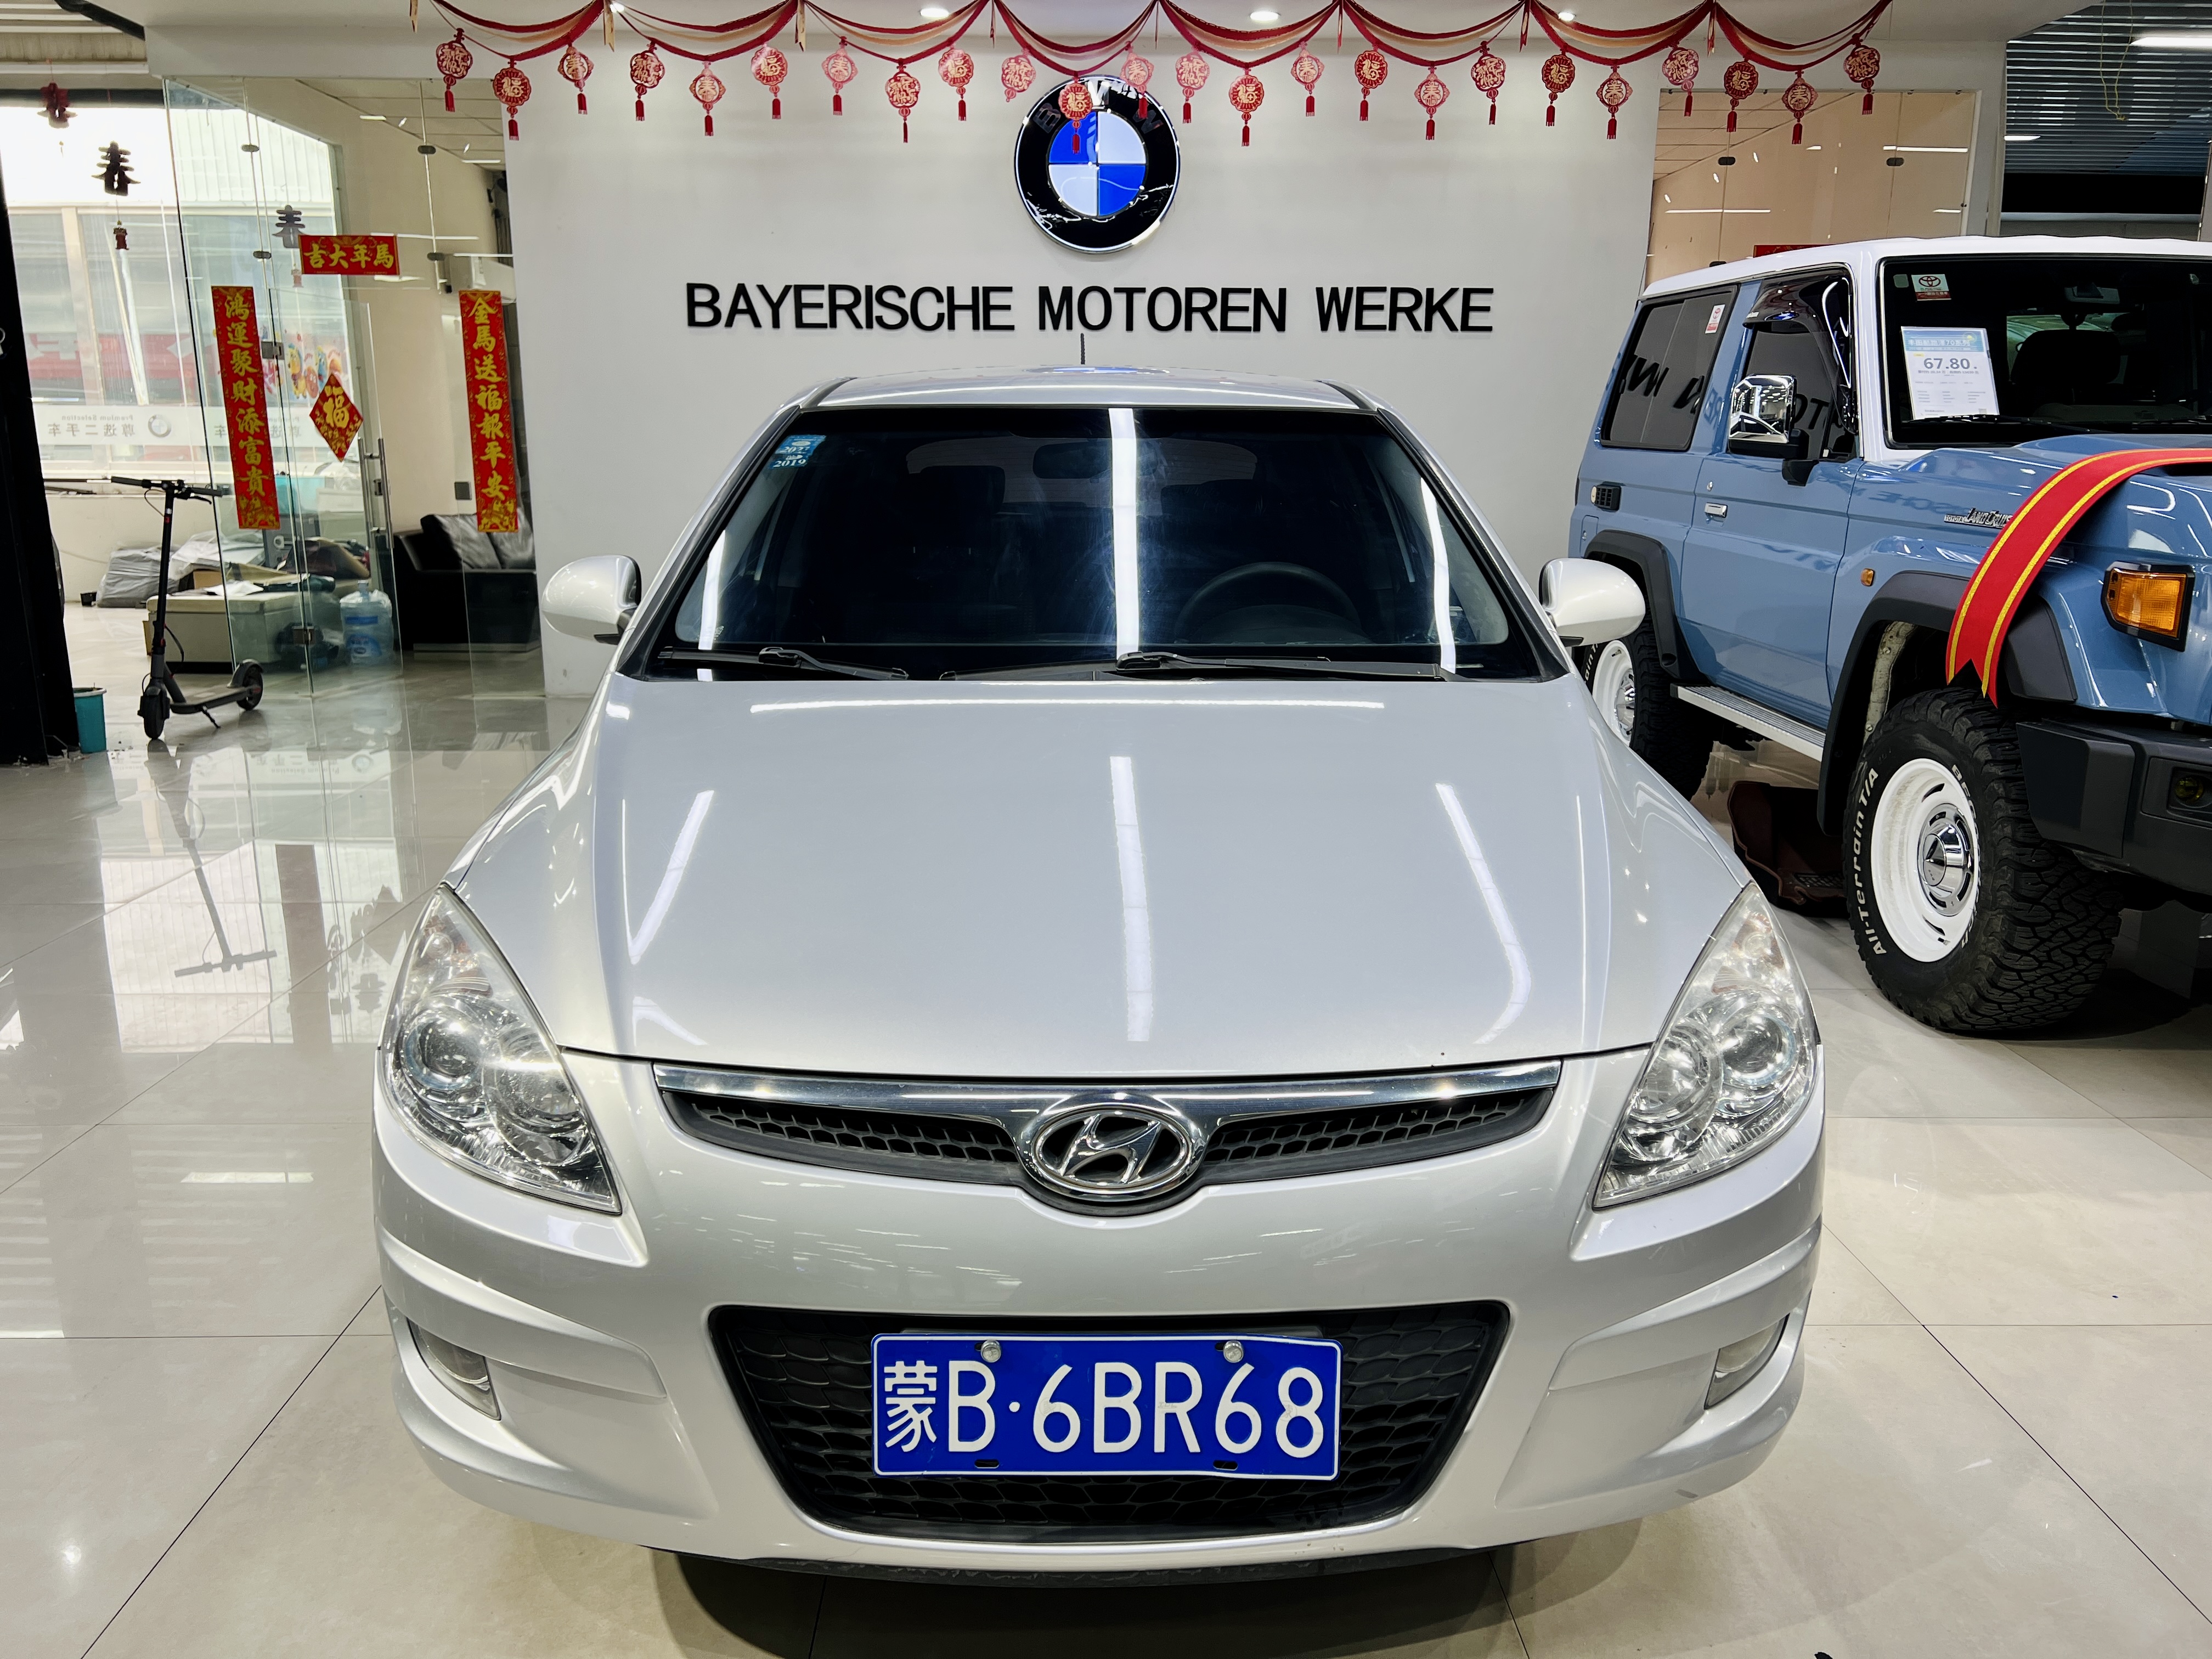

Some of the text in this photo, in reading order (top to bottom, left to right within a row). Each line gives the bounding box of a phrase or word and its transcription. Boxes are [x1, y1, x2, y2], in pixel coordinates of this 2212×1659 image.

[687, 283, 1493, 332] BAYERISCHE MOTOREN WERKE
[323, 385, 350, 429] 福
[772, 459, 806, 467] 2019
[1858, 768, 1878, 807] T/A
